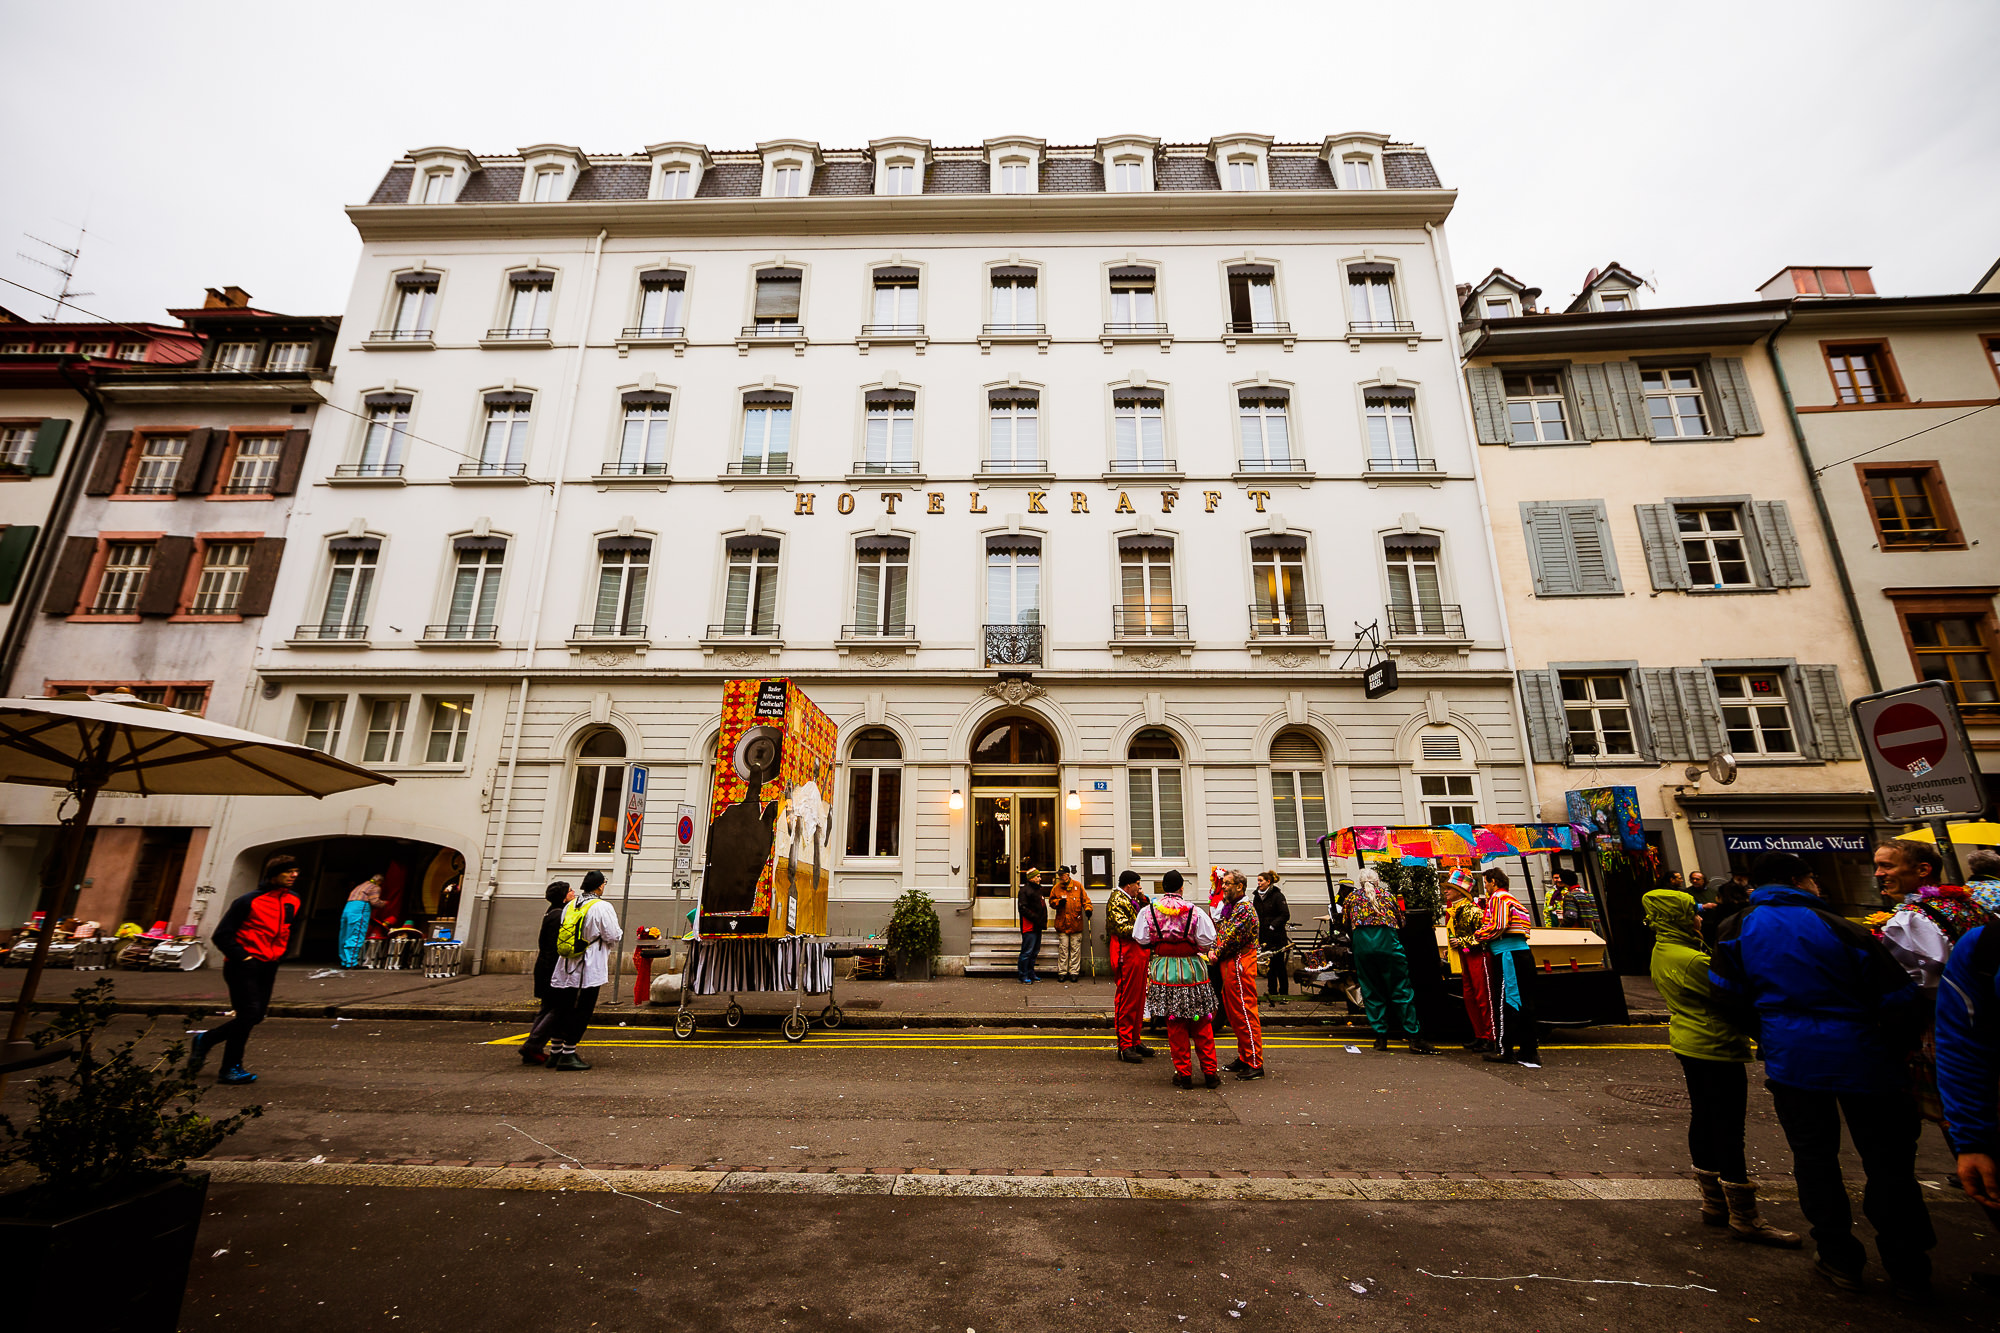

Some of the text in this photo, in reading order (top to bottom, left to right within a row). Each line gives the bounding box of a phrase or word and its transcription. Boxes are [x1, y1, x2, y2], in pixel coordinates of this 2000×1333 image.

[794, 491, 1271, 515] HOTEL KRAFFT
[1753, 681, 1769, 691] 15
[1886, 776, 1967, 793] ausgenommen
[1913, 792, 1945, 804] Velos
[1914, 807, 1925, 815] FC
[1728, 836, 1865, 850] Zum Schmale Wurf
